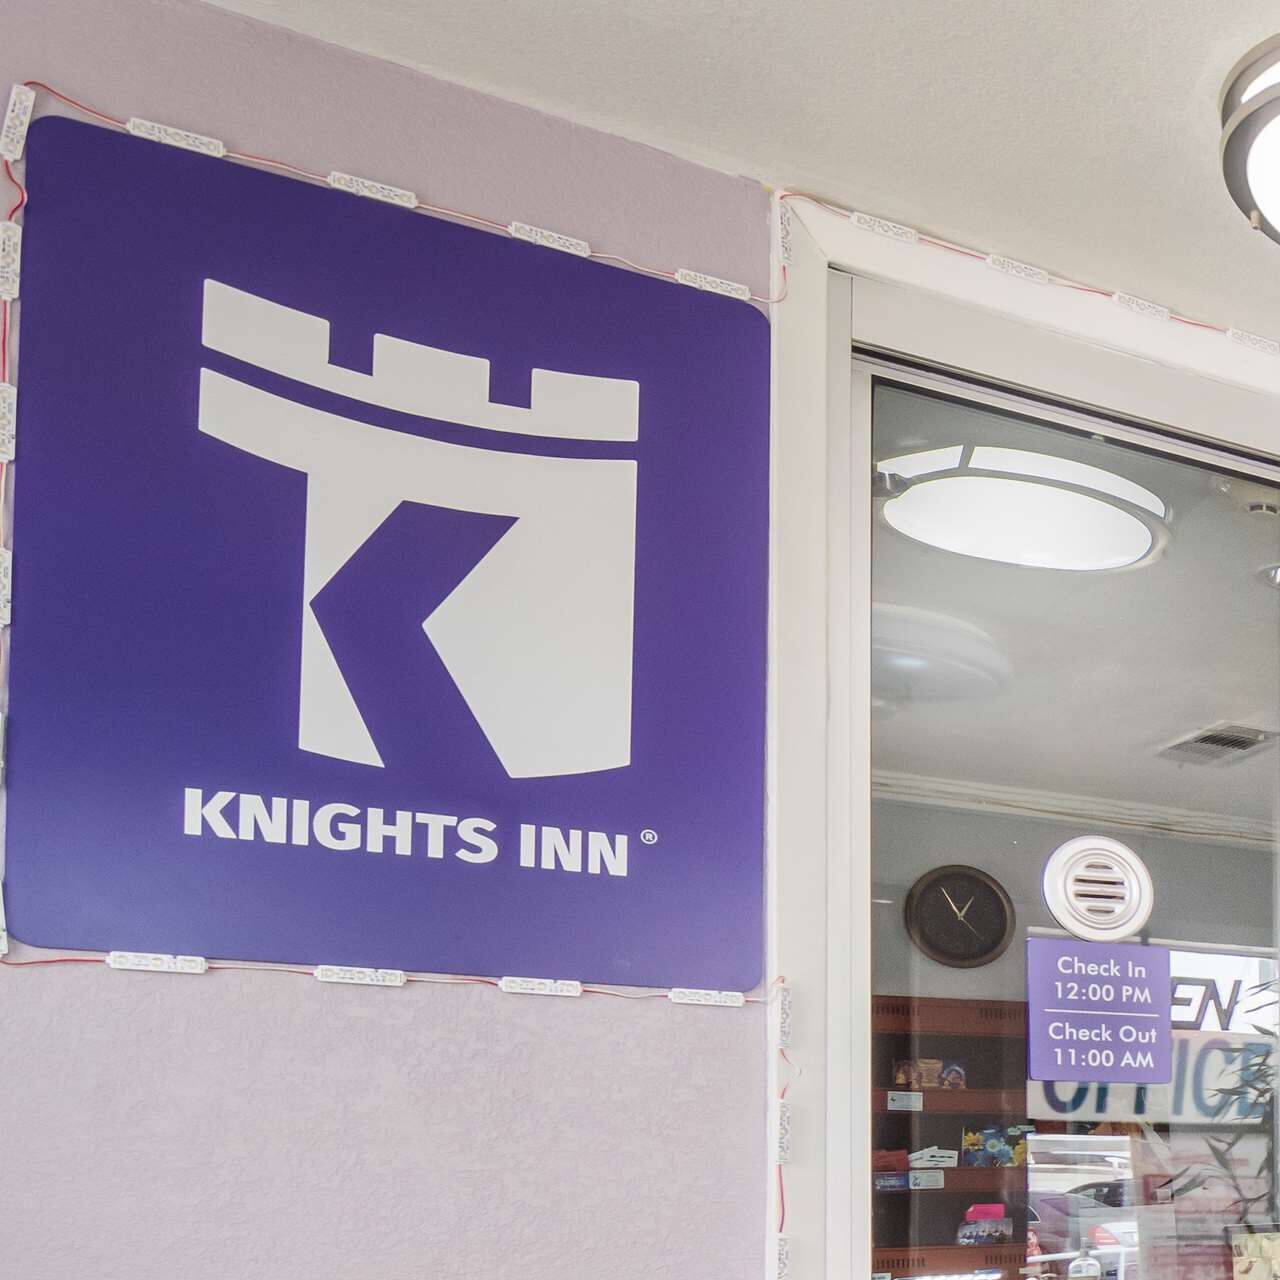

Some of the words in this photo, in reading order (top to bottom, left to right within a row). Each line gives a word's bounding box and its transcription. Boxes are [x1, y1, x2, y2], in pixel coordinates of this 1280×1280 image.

[183, 787, 499, 864] KNIGHTS
[519, 823, 628, 877] INN
[1057, 956, 1121, 977] Check
[1127, 961, 1146, 979] In
[1054, 982, 1114, 1002] 12:00
[1122, 985, 1152, 1004] PM
[1171, 976, 1243, 1031] EN
[1048, 1022, 1112, 1042] Check
[1119, 1025, 1158, 1044] Out
[1054, 1048, 1114, 1068] 11:00
[1120, 1050, 1155, 1068] AM
